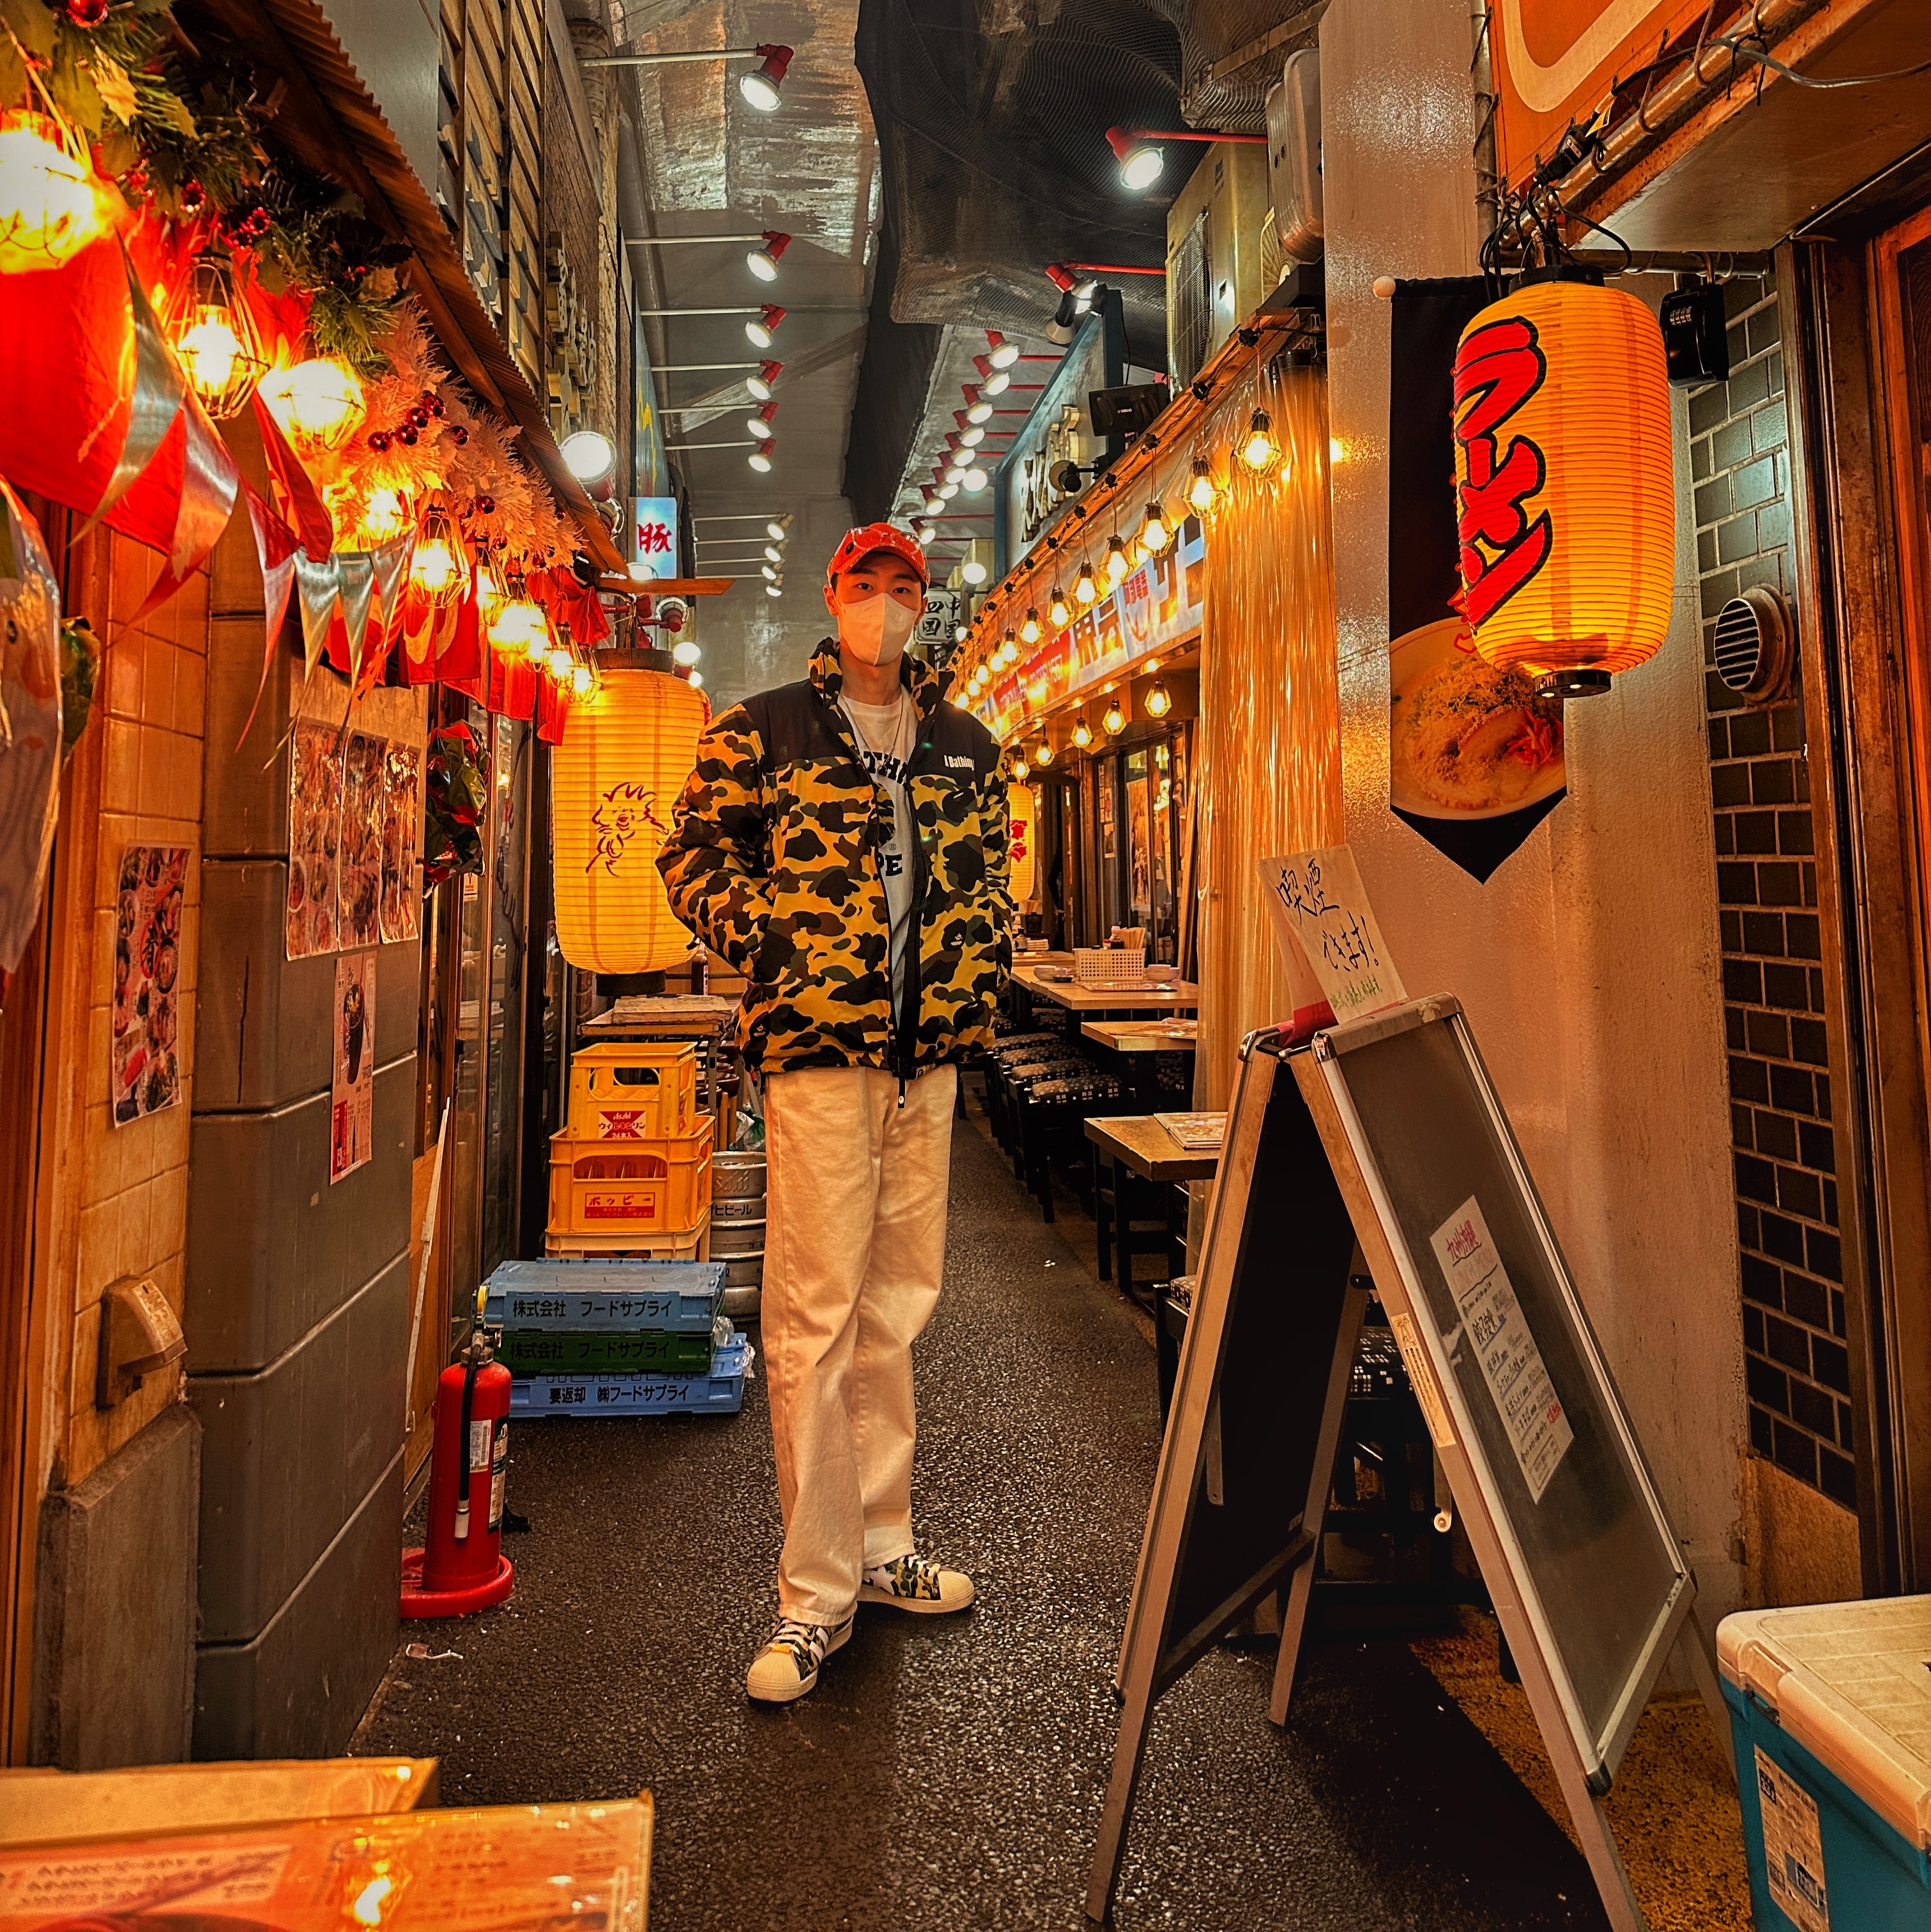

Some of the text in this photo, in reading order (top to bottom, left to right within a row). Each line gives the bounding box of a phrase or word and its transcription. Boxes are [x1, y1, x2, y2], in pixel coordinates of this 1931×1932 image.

[637, 523, 672, 554] 豚
[877, 852, 903, 877] PE
[598, 1122, 646, 1130] ウィルキンソン
[713, 1170, 749, 1193] sahi
[589, 1194, 652, 1206] ホッピー
[513, 1300, 672, 1318] 株式会社 フードサプライ
[510, 1341, 669, 1360] 株式会社 フードサプライ
[549, 1386, 586, 1404] 要返却
